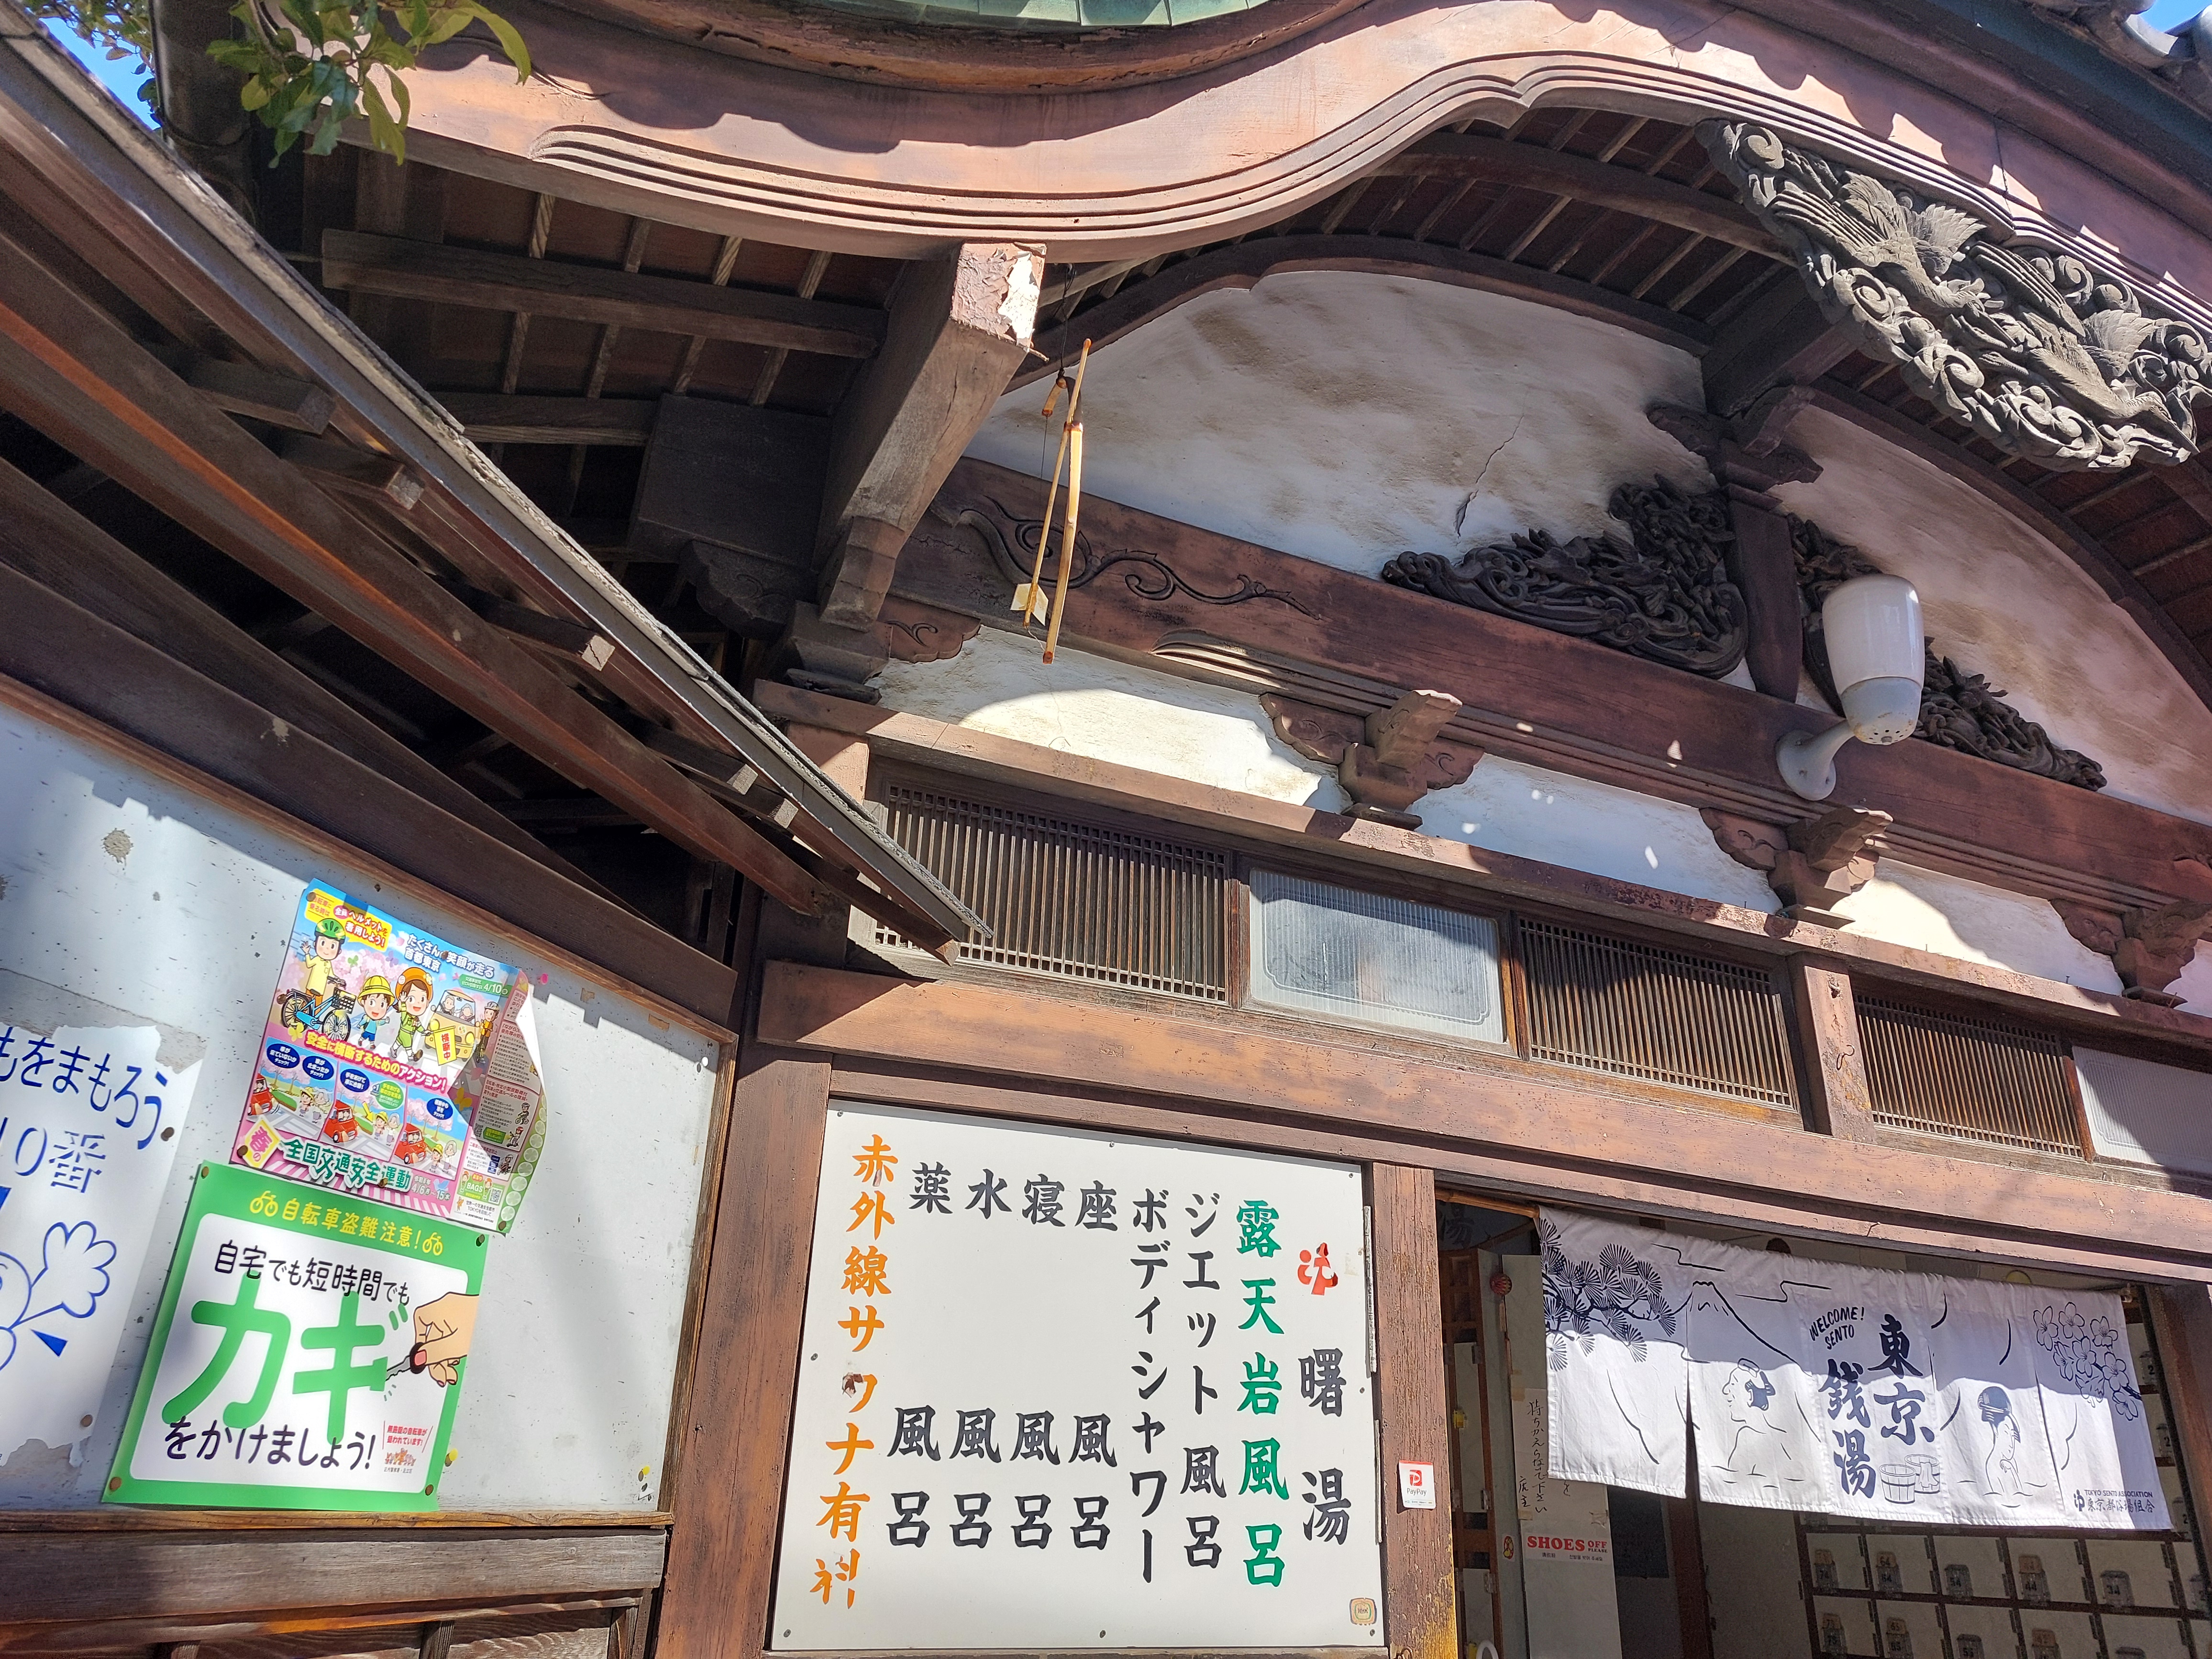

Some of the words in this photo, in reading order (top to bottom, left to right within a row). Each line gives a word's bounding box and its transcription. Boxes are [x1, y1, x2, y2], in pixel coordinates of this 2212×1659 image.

[404, 947, 442, 973] 首都東京
[306, 1031, 447, 1092] 安全に横断するためのアクション!
[441, 1033, 451, 1061] 横断中
[251, 1125, 273, 1162] 春の
[285, 1138, 412, 1190] 全国交通安全運動
[466, 1183, 483, 1193] BAGS
[282, 1198, 420, 1252] 自転車盗難注意!
[214, 1239, 411, 1306] 自宅でも短時間でも
[1809, 1306, 1865, 1341] WELCOME!
[1825, 1324, 1855, 1350] SENTO
[161, 1271, 409, 1446] カギ
[1868, 1313, 1936, 1446] 東京
[1236, 1199, 1290, 1588] 露天岩風呂
[165, 1416, 376, 1470] をかけましょう!
[1818, 1358, 1877, 1500] 銭湯
[1406, 1488, 1427, 1496] PayPay
[2118, 1490, 2153, 1498] ASSOCIATION
[1527, 1536, 1585, 1552] SHOES
[1587, 1540, 1607, 1548] OFF
